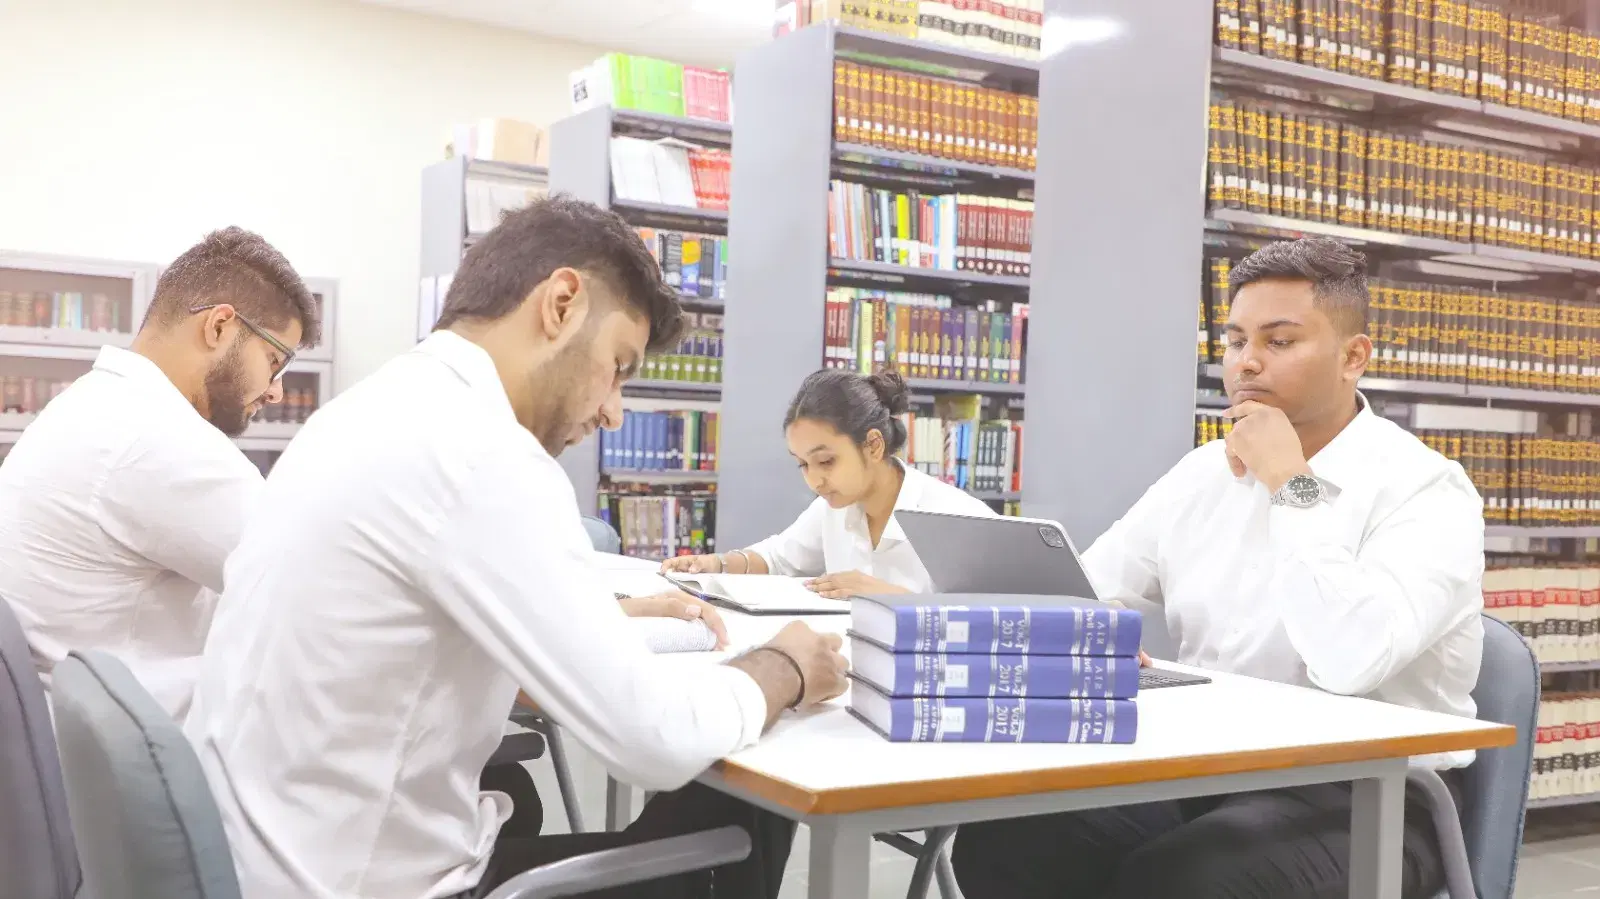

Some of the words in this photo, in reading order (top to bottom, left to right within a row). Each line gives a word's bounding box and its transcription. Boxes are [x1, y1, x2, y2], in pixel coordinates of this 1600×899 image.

[1001, 620, 1014, 648] 2017
[998, 664, 1011, 693] 2017
[995, 705, 1008, 734] 2017
[1093, 711, 1103, 736] AIR
